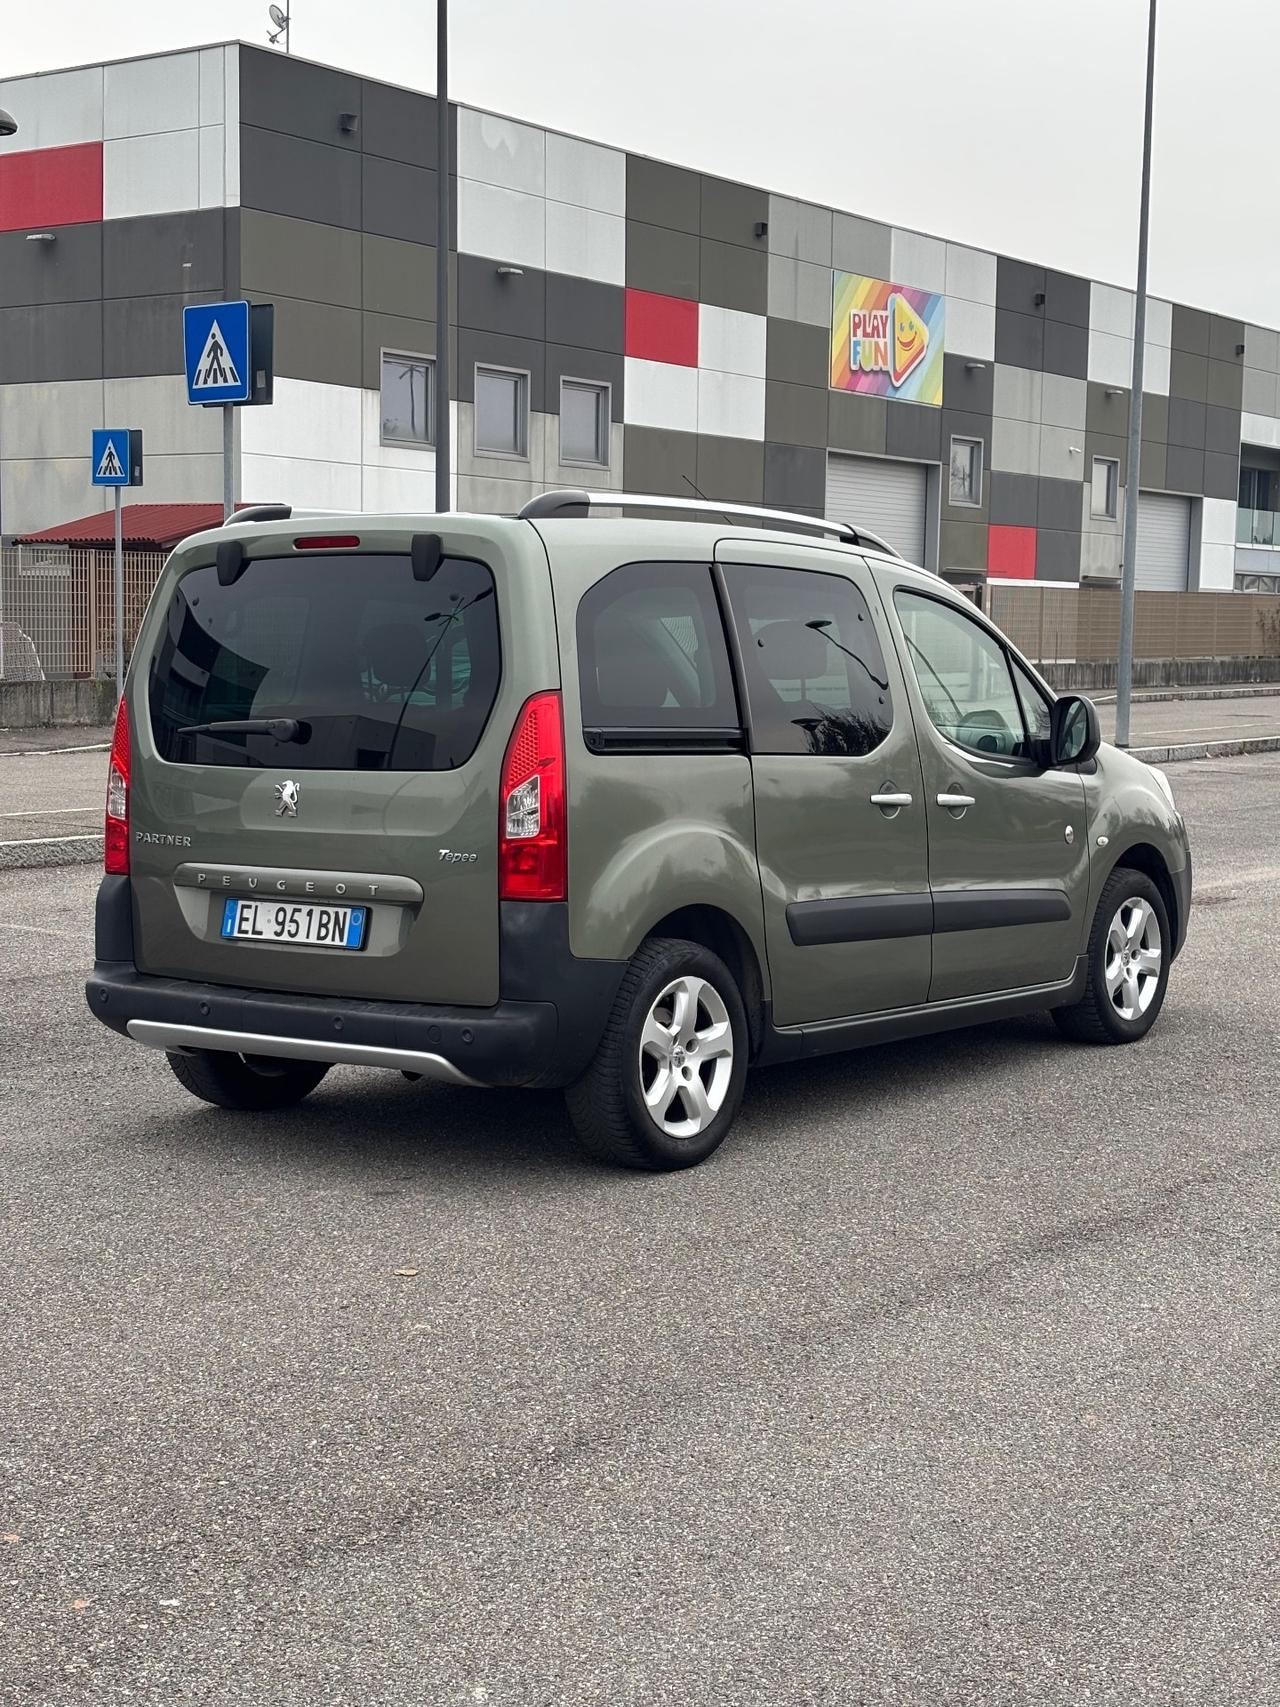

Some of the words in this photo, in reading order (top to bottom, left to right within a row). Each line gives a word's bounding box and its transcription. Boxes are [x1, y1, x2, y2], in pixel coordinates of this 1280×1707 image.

[852, 313, 888, 339] PLAY
[852, 340, 888, 368] FUN
[135, 831, 191, 847] PARTNER
[438, 849, 477, 863] Tepee
[197, 873, 379, 896] PEUGEOT
[237, 904, 263, 936] EL
[273, 906, 348, 943] 951BN
